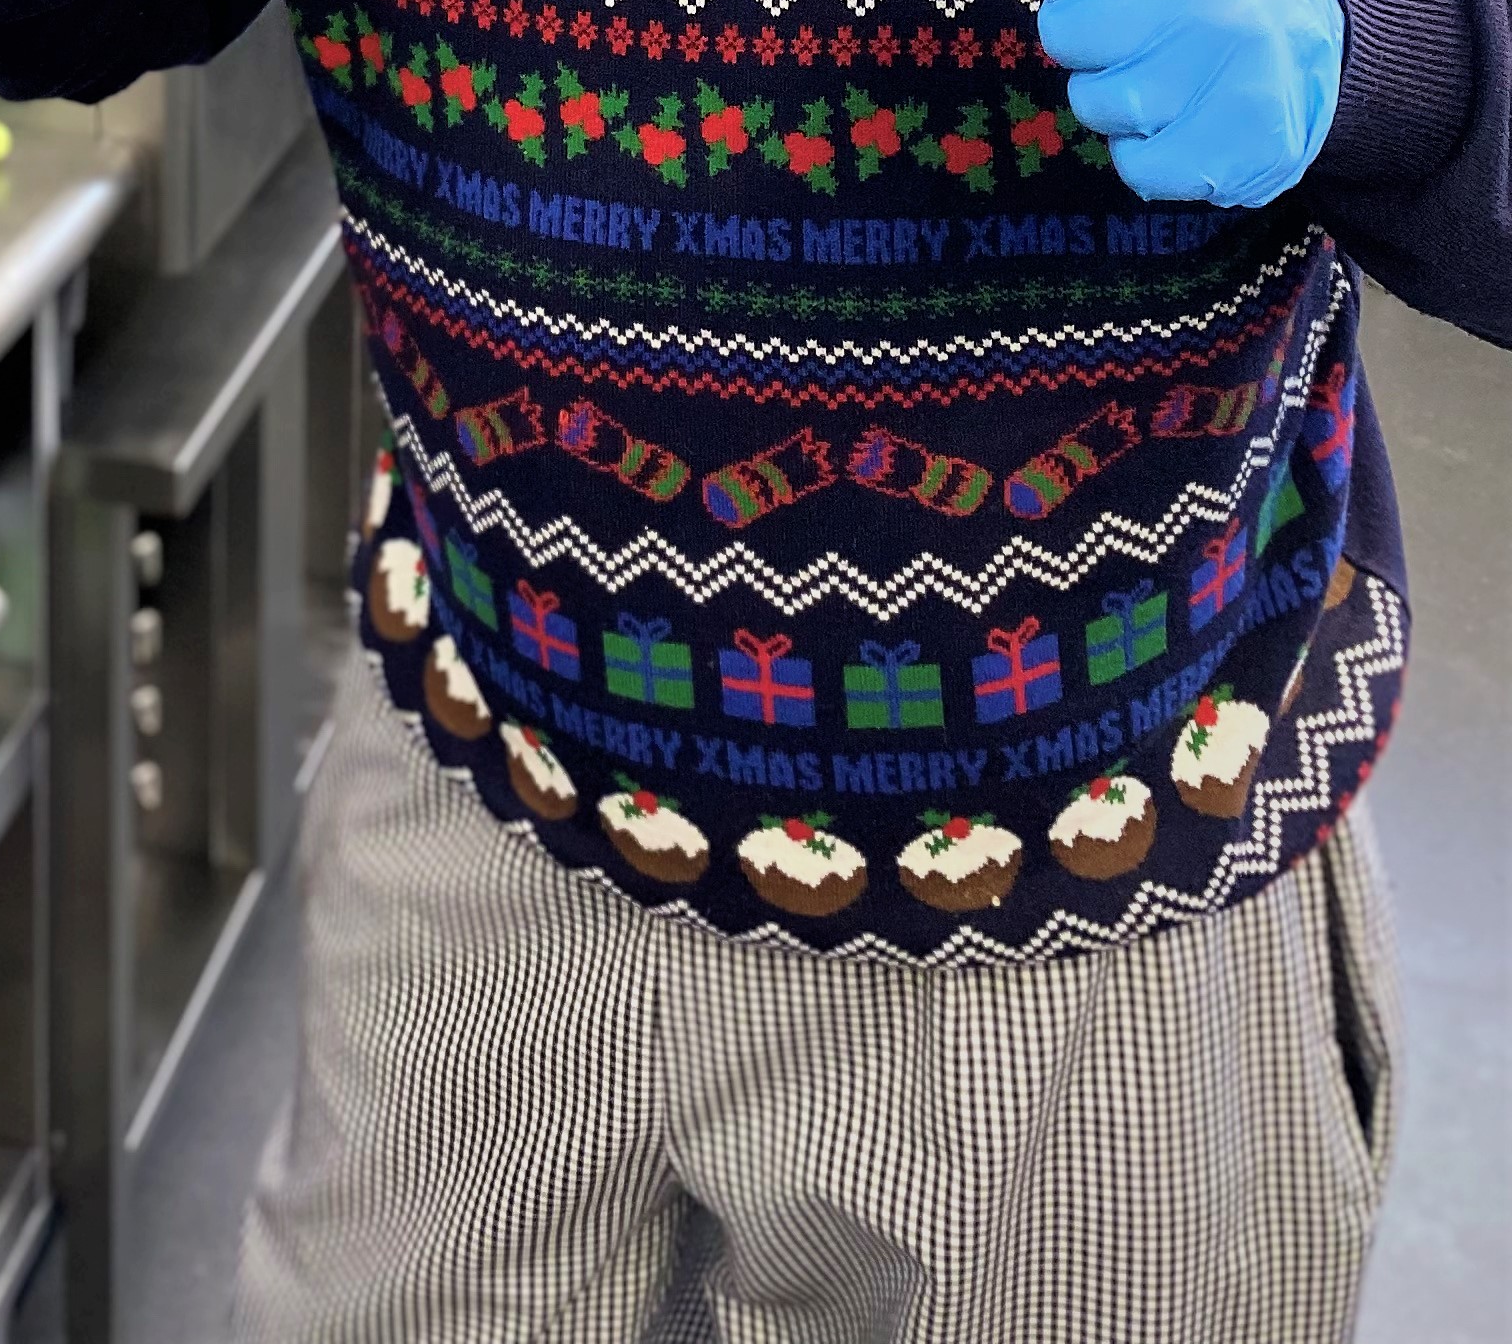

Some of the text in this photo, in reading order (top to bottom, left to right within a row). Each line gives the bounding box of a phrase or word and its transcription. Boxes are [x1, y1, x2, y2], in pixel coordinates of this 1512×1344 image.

[435, 155, 521, 229] XMAS
[529, 188, 660, 252] MERRY
[672, 211, 790, 262] XMAS
[803, 217, 950, 265] MERRY
[964, 214, 1095, 258] XMAS
[552, 692, 680, 770] MERRY
[695, 736, 823, 791] XMAS
[833, 746, 986, 795] MERRY
[1003, 714, 1124, 783] XMAS
